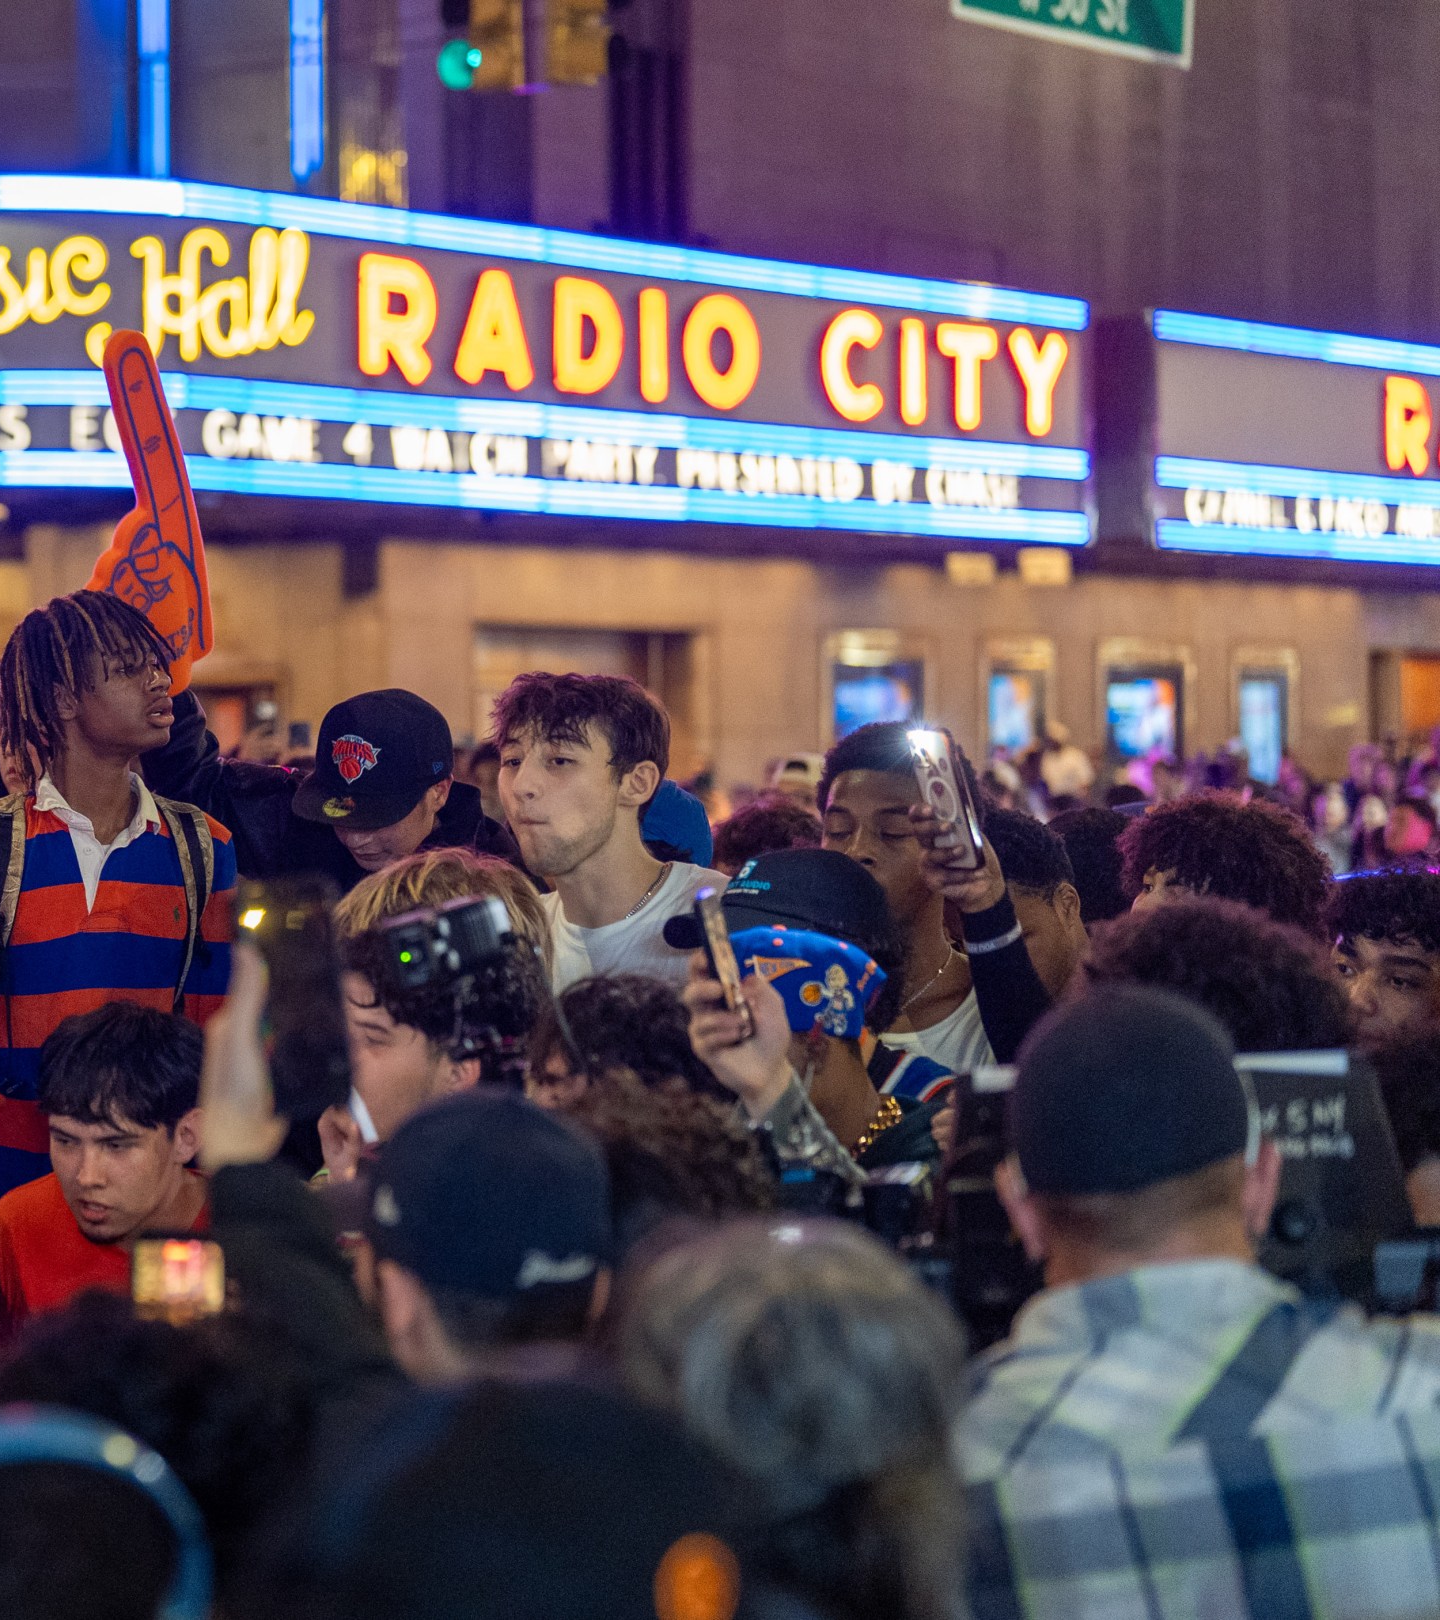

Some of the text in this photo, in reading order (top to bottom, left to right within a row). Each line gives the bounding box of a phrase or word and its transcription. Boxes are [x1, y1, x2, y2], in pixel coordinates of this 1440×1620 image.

[85, 226, 315, 368] Hall
[357, 251, 761, 410] RADIO
[820, 308, 1068, 437] CITY
[202, 408, 323, 466] GAME
[342, 420, 374, 467] 4
[389, 424, 528, 478] WATCH
[541, 435, 659, 485] PARTY
[740, 880, 772, 891] AUDIO
